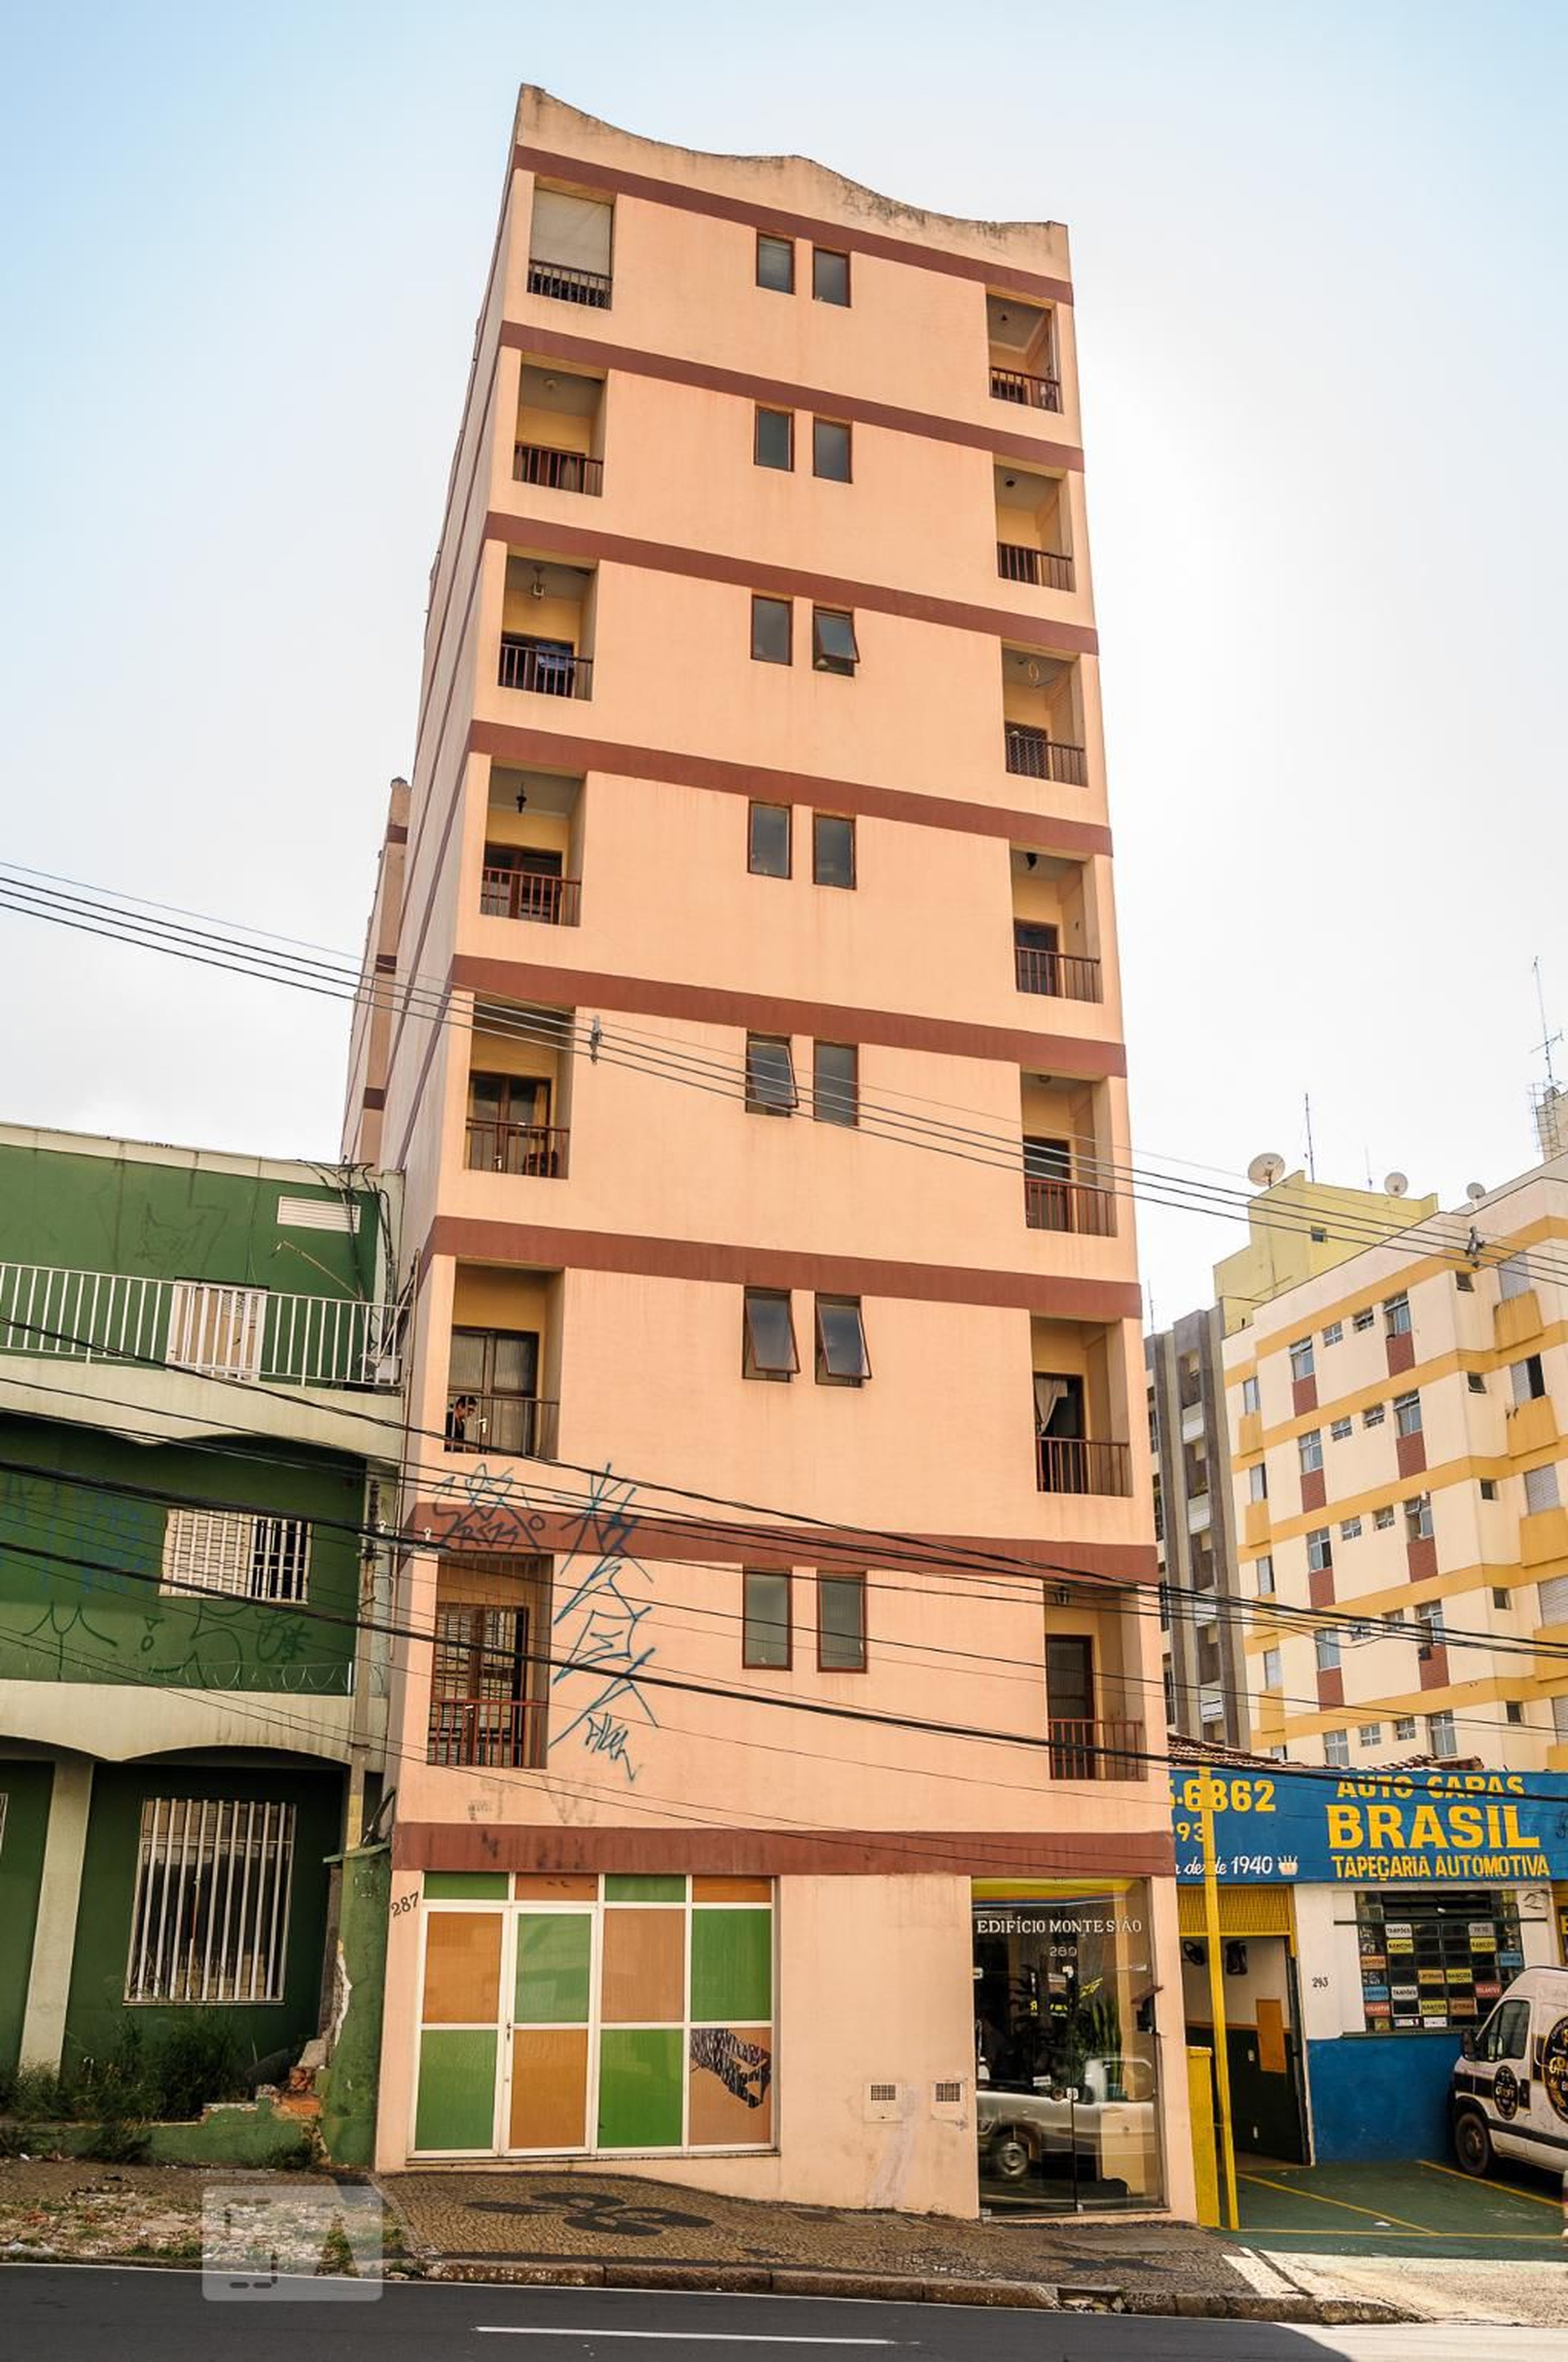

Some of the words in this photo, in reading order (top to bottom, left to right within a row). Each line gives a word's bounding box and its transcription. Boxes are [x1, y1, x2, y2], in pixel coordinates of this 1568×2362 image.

[1336, 1775, 1414, 1799] AUTO
[1427, 1775, 1525, 1799] CAPAS
[1325, 1804, 1541, 1849] BRASIL
[1183, 1856, 1227, 1875] dede
[1230, 1856, 1273, 1875] 1940
[1331, 1856, 1431, 1881] TAPEÇARIA
[1435, 1855, 1550, 1877] AUTOMOTIVA
[391, 1891, 419, 1918] 287
[1049, 1919, 1104, 1933] MONTE
